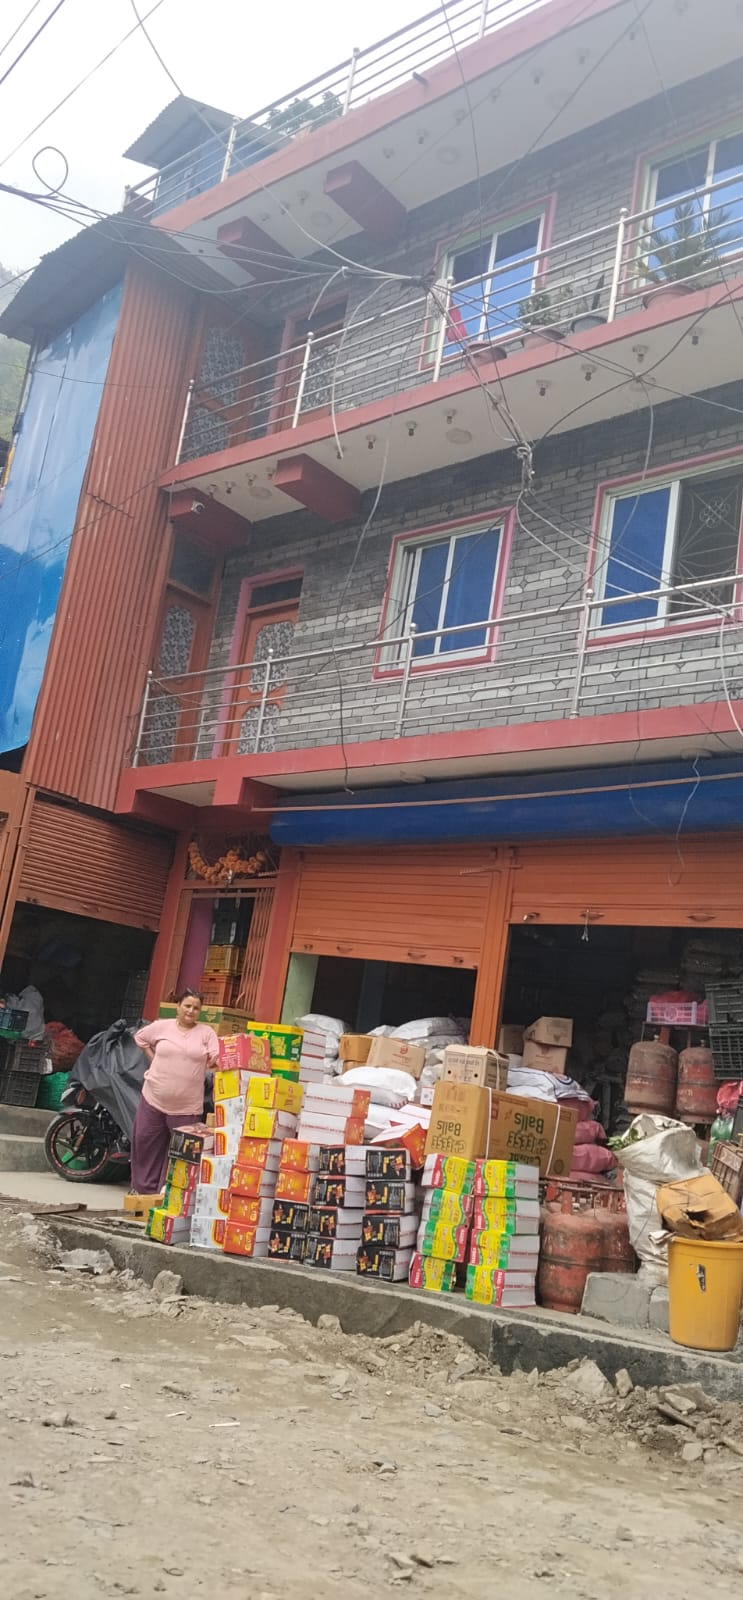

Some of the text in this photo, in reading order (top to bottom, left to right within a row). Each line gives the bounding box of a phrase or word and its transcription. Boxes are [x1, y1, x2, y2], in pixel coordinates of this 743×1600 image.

[436, 1120, 461, 1137] Balls
[514, 1112, 544, 1134] Balls
[507, 1131, 548, 1154] CHEESE
